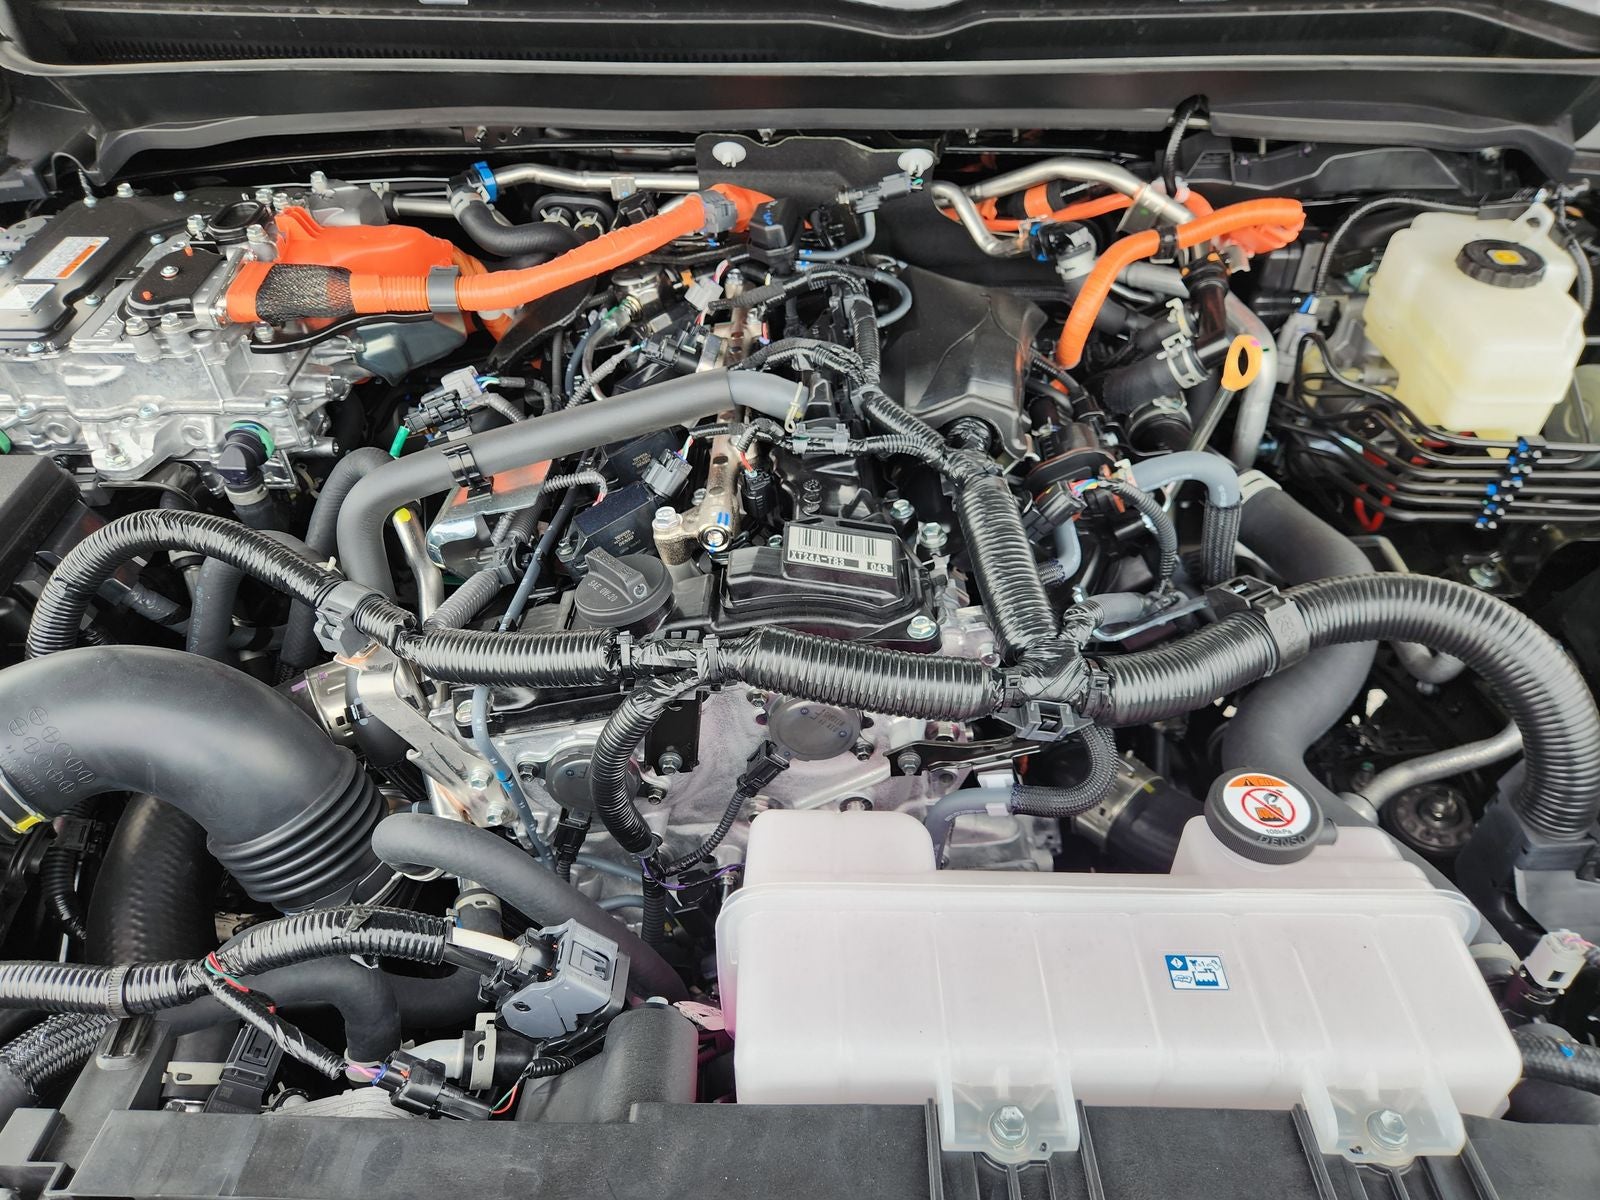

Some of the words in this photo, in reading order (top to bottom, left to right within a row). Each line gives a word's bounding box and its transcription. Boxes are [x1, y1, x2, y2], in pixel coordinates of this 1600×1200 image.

[789, 550, 846, 567] XT24A-T83
[870, 562, 889, 573] 043
[587, 579, 602, 591] SAE
[1258, 834, 1307, 847] DENSO
